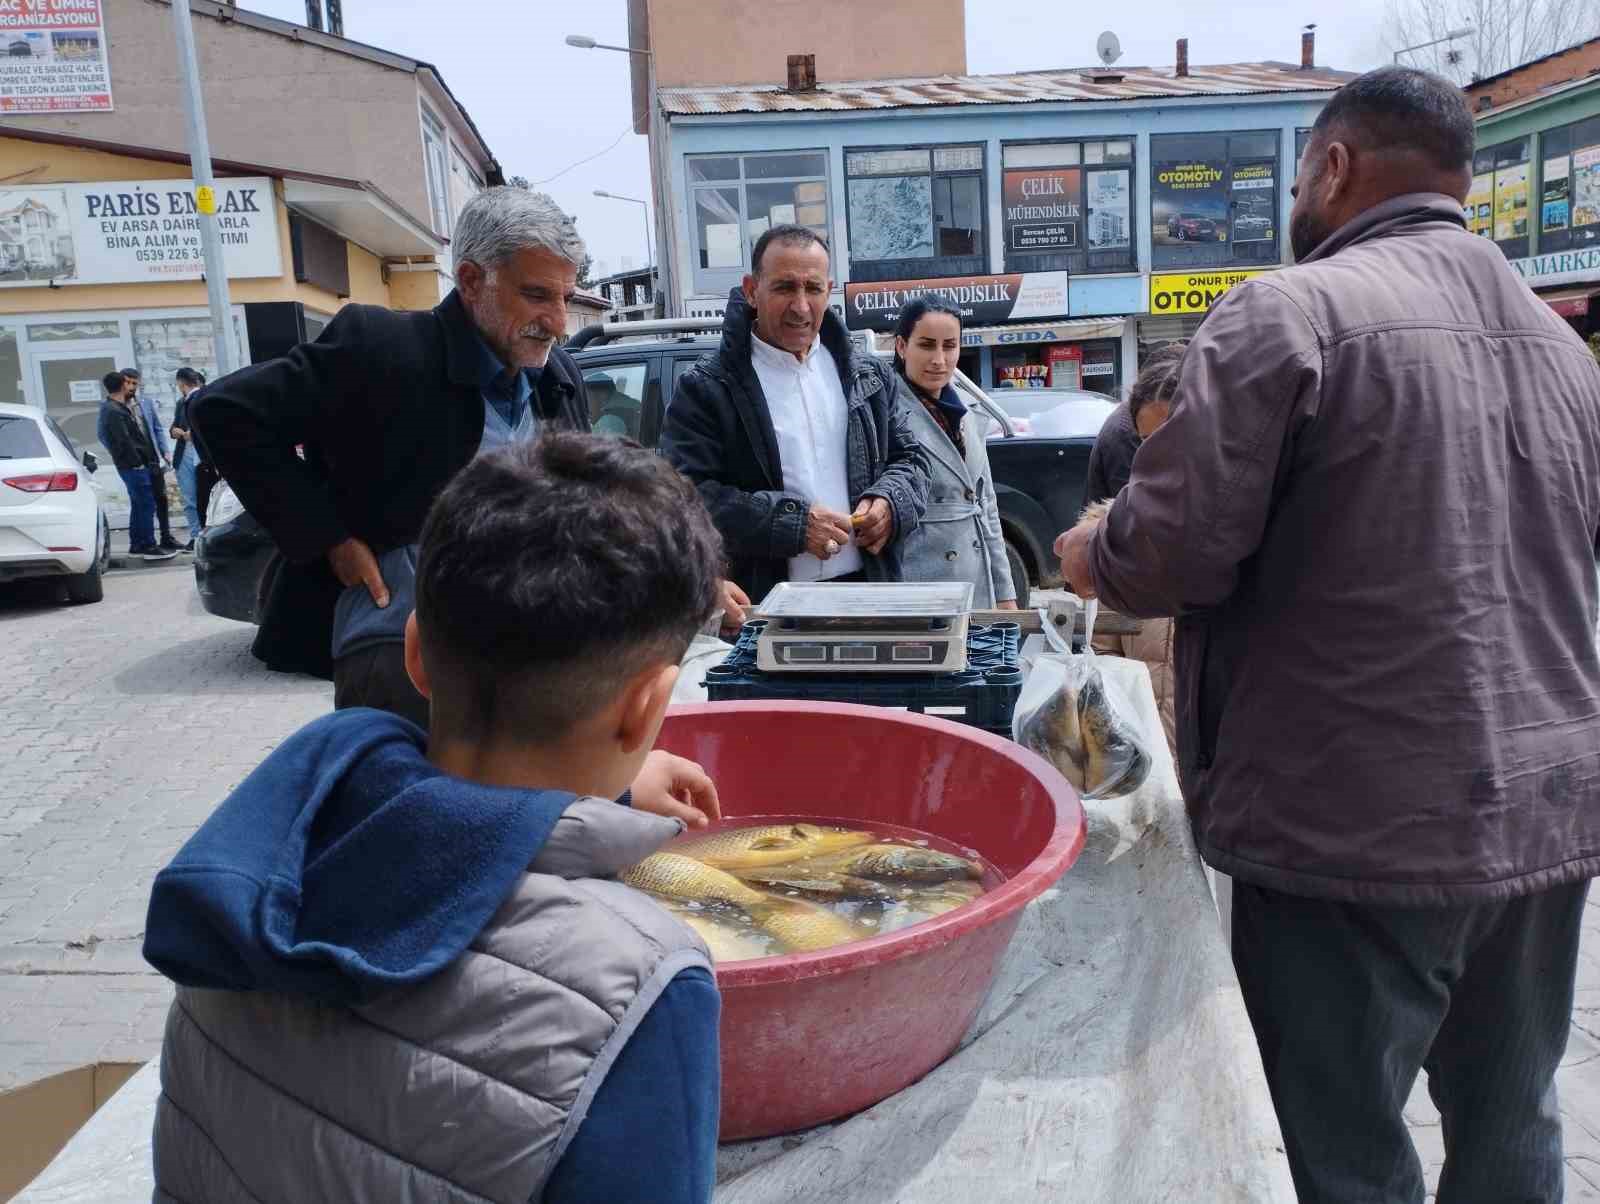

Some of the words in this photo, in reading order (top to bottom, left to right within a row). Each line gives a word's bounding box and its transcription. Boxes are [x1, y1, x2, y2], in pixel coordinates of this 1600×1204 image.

[0, 0, 20, 10] AC
[0, 11, 97, 25] RGANİZASYONU
[1159, 168, 1222, 183] OTOMOTİV
[1022, 174, 1064, 200] ÇELİK
[85, 186, 160, 218] PARİS
[166, 189, 260, 215] EMAK
[1008, 202, 1080, 220] MÜHENDİSLİK
[101, 221, 117, 233] EV
[122, 219, 159, 232] ARSA
[218, 217, 249, 229] RLA
[106, 235, 140, 249] BİNA
[145, 235, 178, 247] ALIM
[182, 237, 198, 246] ve
[221, 233, 249, 244] TIMI
[136, 249, 164, 262] 0539
[1530, 251, 1600, 277] MARKE
[1188, 277, 1221, 287] ONUR
[855, 287, 899, 315] ÇELİK
[902, 279, 1011, 304] MÜENDİSLİK
[1154, 289, 1224, 310] OTOM
[998, 330, 1057, 342] GIDA
